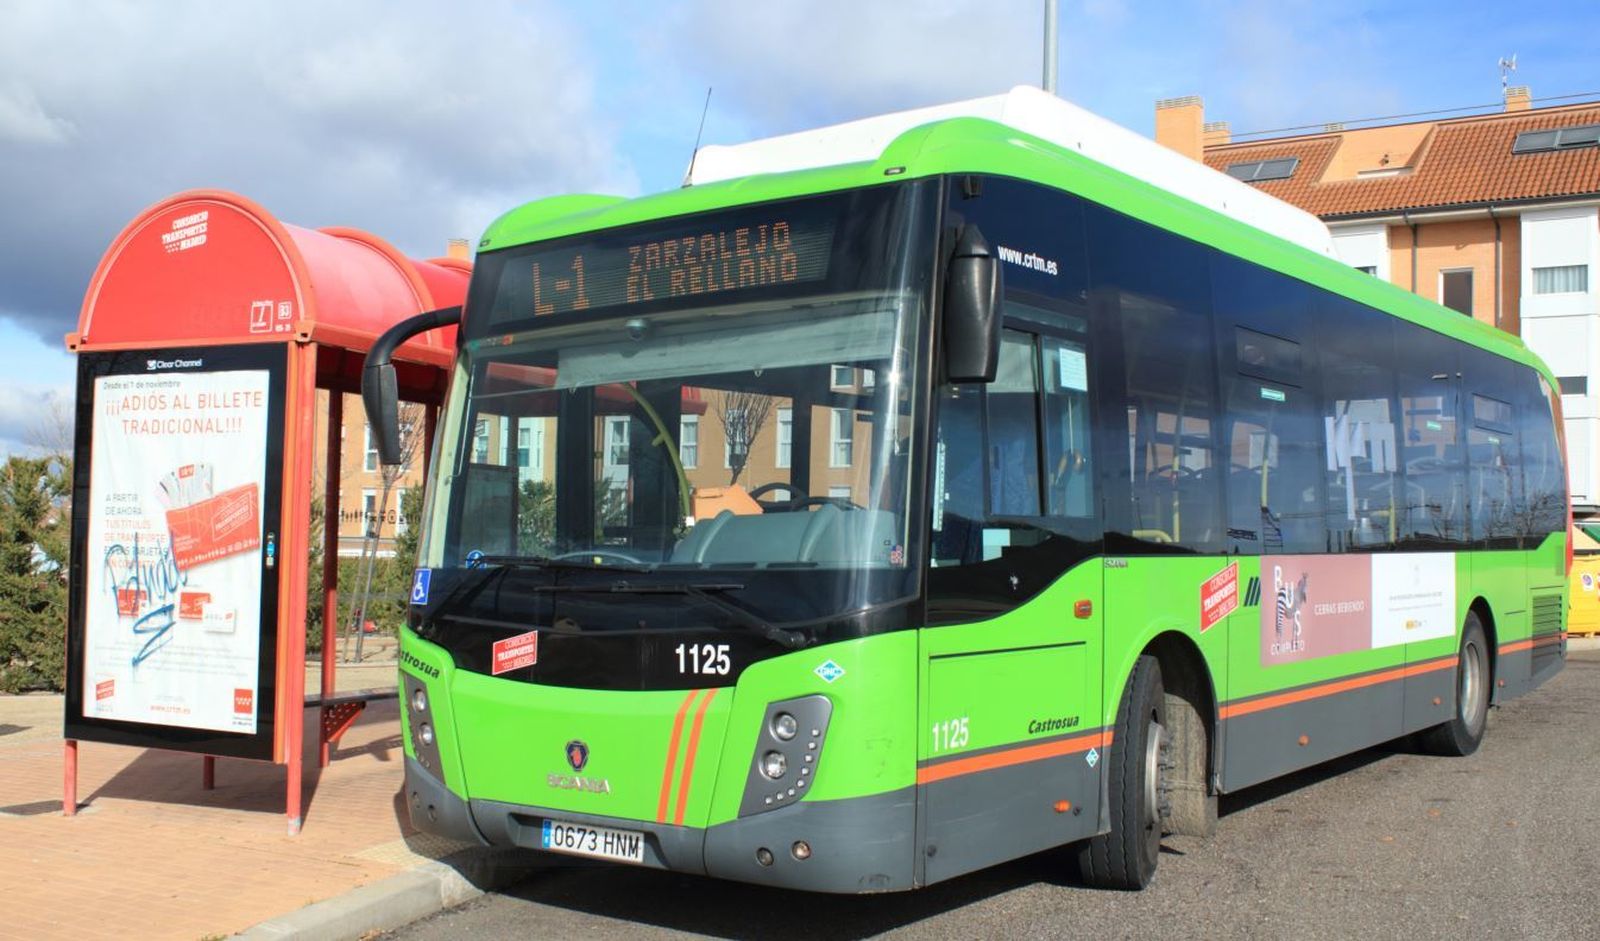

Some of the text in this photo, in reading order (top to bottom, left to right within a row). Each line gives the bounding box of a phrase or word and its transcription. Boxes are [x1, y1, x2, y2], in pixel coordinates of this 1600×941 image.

[628, 221, 792, 271] ZARZALEJO
[997, 245, 1058, 275] www.crtm.es
[532, 254, 590, 317] L-1
[626, 251, 798, 303] EL RELLANO
[157, 359, 202, 369] Clear Channel
[104, 381, 121, 390] Desde
[136, 381, 143, 389] de
[146, 380, 180, 388] noviembre
[173, 395, 192, 409] AL
[198, 391, 263, 409] BILLETE
[121, 417, 242, 436] TRADICIONAL!!!
[674, 643, 731, 675] 1125
[932, 717, 969, 753] 1125
[1028, 716, 1079, 734] Castrosua
[547, 773, 609, 795] SCANIA
[554, 825, 640, 858] 0673 HNM
